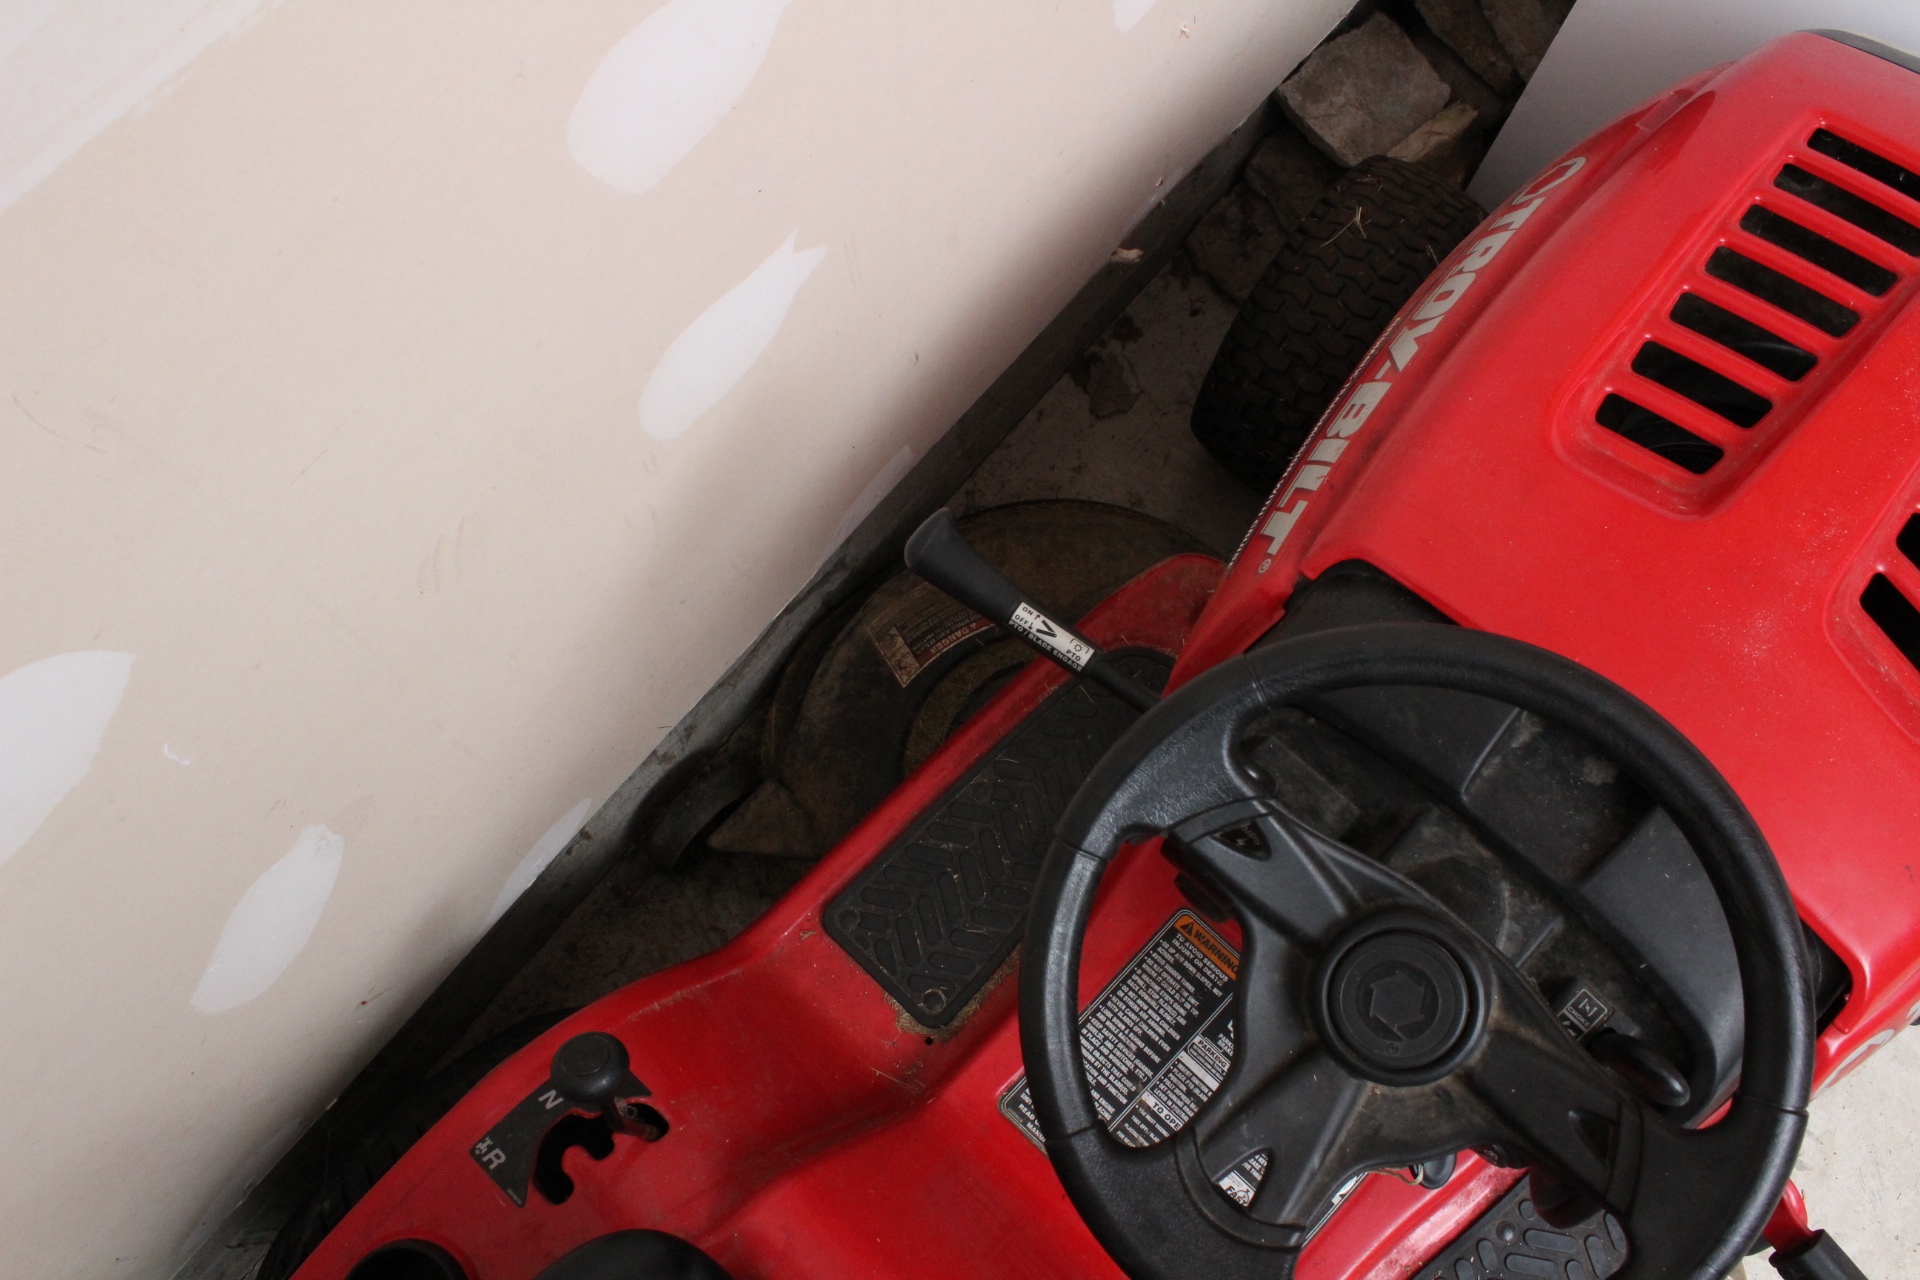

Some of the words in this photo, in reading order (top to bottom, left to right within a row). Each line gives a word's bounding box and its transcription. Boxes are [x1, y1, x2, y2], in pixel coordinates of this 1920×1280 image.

[1260, 197, 1546, 556] TROY-BILT
[1014, 614, 1029, 625] OFF
[1022, 606, 1034, 616] ON
[930, 627, 970, 654] DANGER
[1008, 620, 1024, 632] PTO
[1028, 634, 1052, 651] BLADE
[1052, 649, 1083, 672] ENGAGE
[1066, 649, 1081, 662] PTO
[1240, 824, 1263, 846] MPS
[1171, 938, 1194, 959] INJURY
[1192, 958, 1203, 968] OR
[1174, 932, 1185, 942] TO
[1183, 941, 1204, 959] AVOID
[1201, 957, 1229, 982] SERIOUS
[1173, 992, 1185, 1003] SLP
[1095, 1011, 1107, 1022] AND
[1196, 1039, 1228, 1068] PARKING
[538, 1090, 564, 1110] N
[1150, 1101, 1164, 1114] TO
[1016, 1102, 1036, 1120] READ
[1024, 1121, 1048, 1142] MANU
[482, 1148, 506, 1170] R
